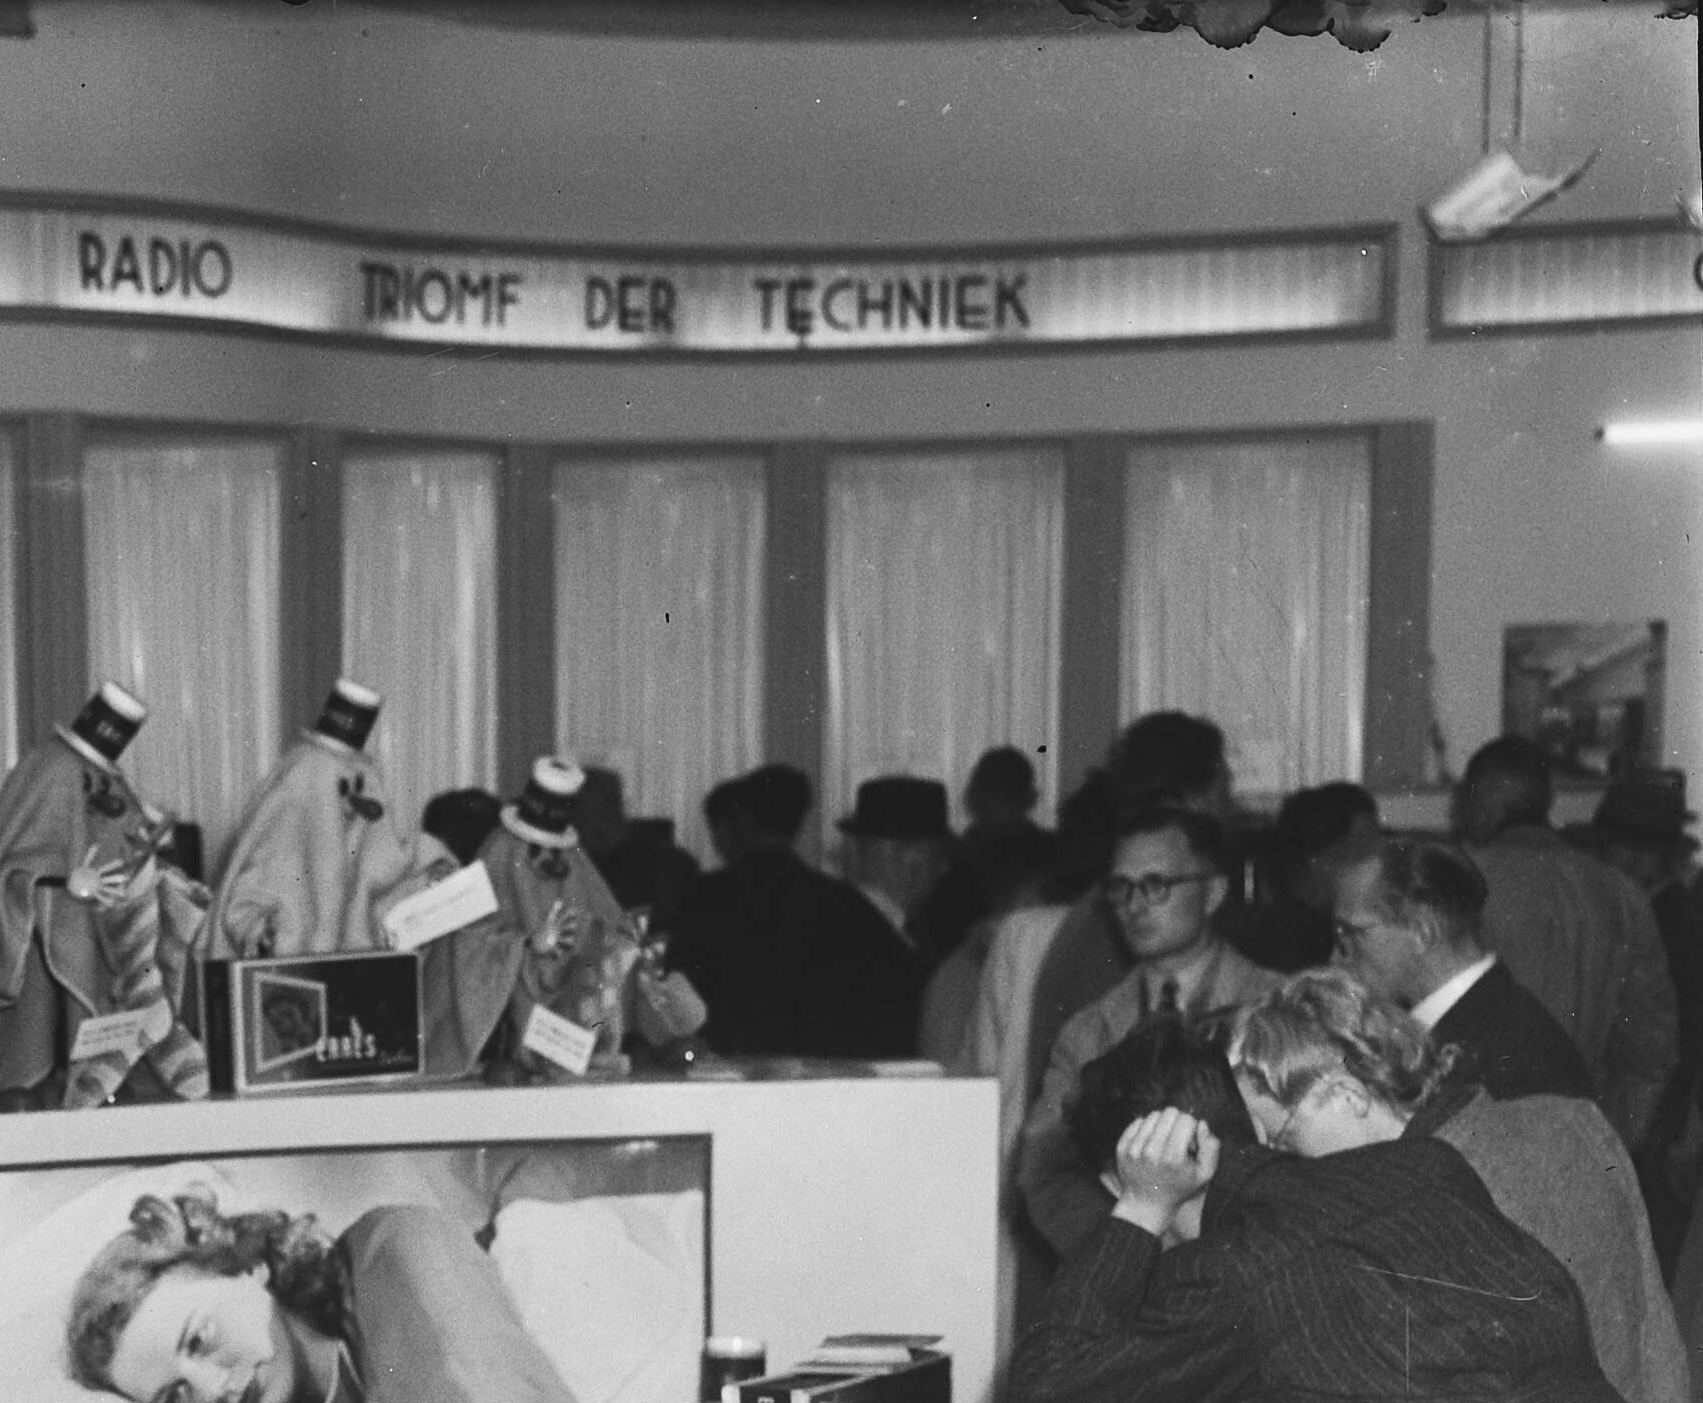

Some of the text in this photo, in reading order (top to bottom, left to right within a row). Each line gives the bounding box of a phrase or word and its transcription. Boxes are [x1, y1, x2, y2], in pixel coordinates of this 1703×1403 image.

[77, 230, 234, 299] RADIO
[358, 260, 523, 326] TRIOMF
[583, 274, 678, 334] DER
[752, 271, 1031, 335] TECHNIEK
